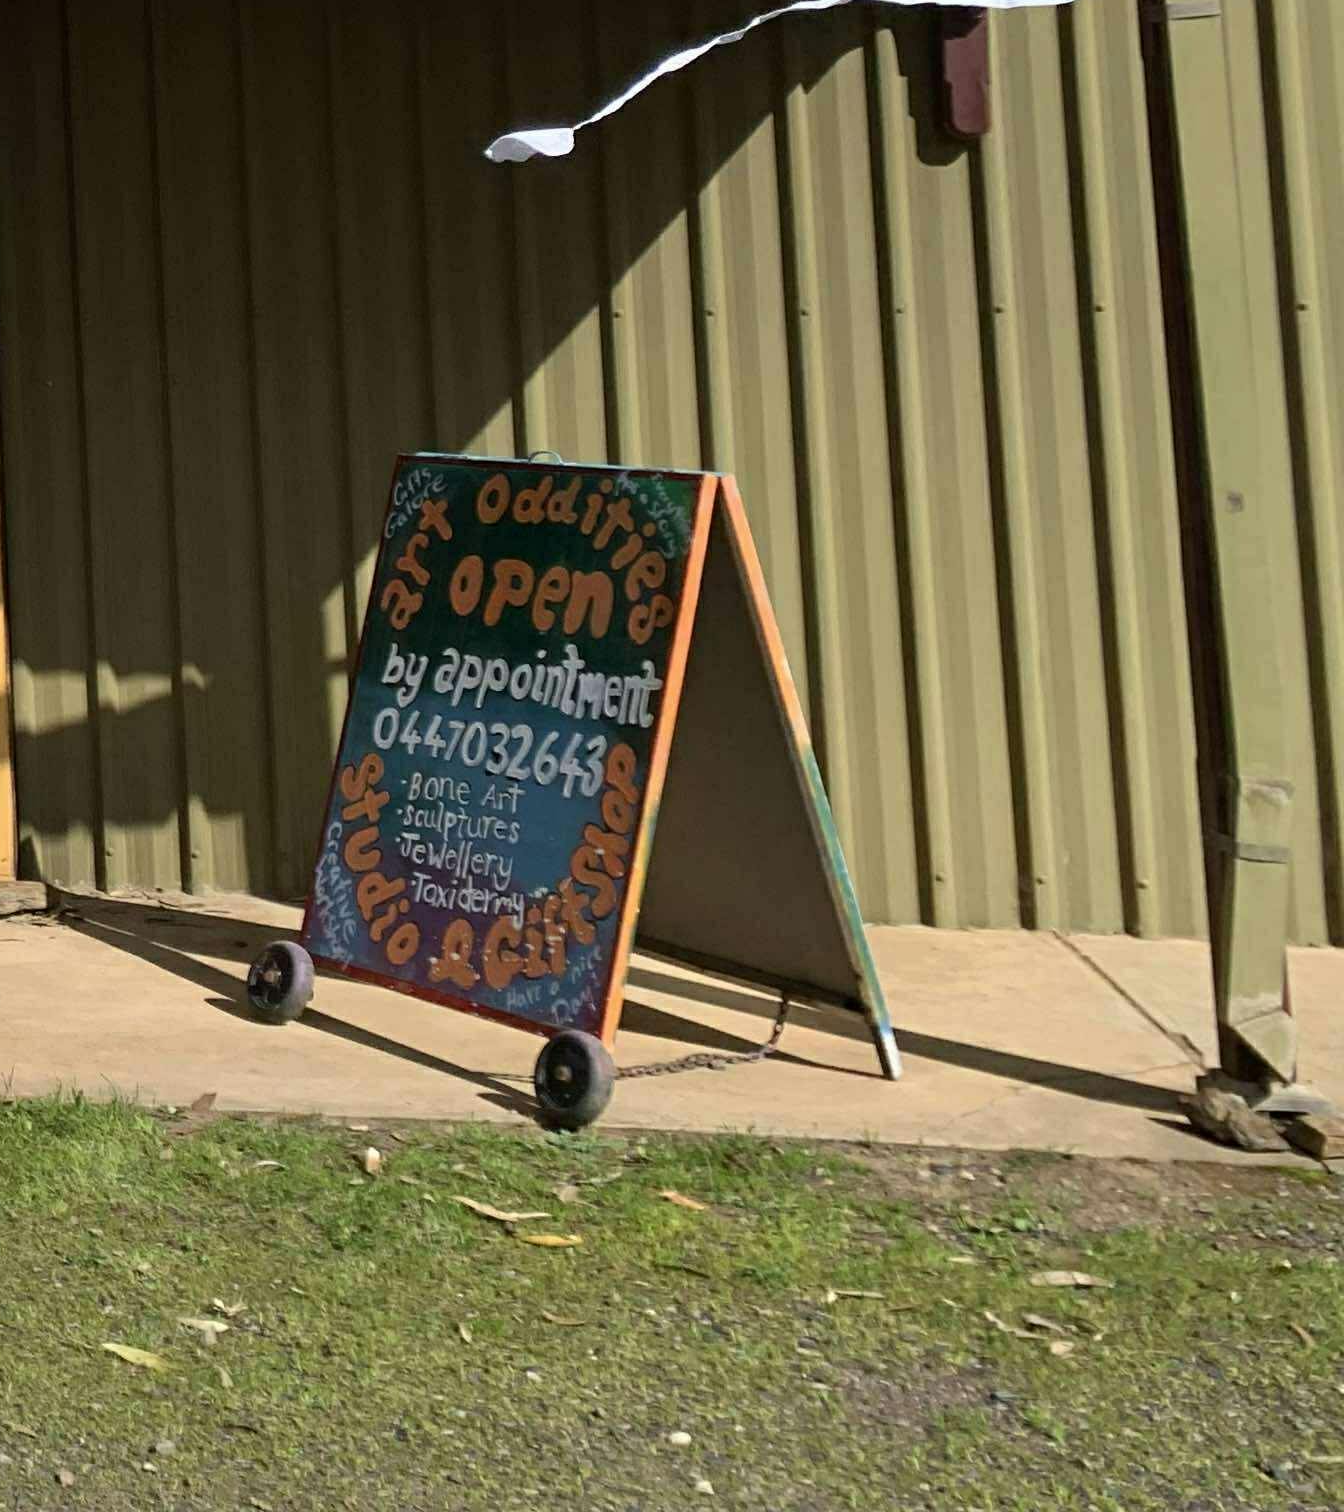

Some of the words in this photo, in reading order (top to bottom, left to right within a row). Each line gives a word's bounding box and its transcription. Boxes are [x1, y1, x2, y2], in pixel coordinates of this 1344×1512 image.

[449, 554, 614, 639] open
[476, 472, 675, 646] Oddities
[381, 643, 430, 708] by
[433, 643, 663, 728] appointment
[373, 707, 609, 799] 0447032643
[408, 772, 472, 805] Bone
[481, 783, 526, 814] Art
[400, 832, 513, 892] Jewellery
[412, 872, 525, 931] Taxidermy
